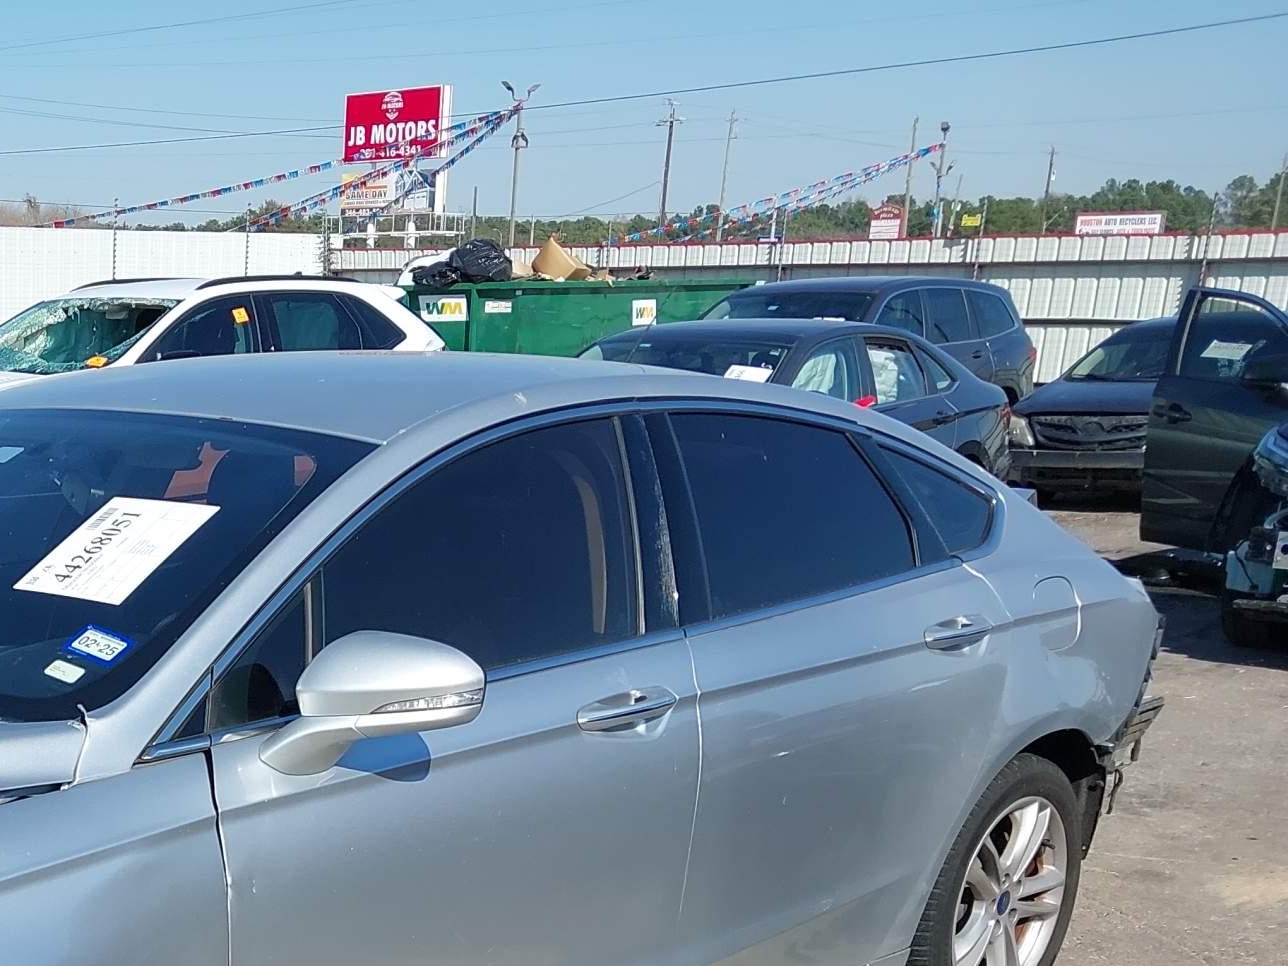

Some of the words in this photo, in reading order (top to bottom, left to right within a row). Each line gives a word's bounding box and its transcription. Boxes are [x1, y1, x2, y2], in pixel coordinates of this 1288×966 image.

[348, 125, 366, 147] JB
[370, 119, 436, 145] MOTORS
[345, 190, 369, 200] SAME
[372, 189, 388, 199] DAY
[425, 302, 464, 315] WM
[635, 306, 654, 319] WM
[54, 511, 142, 584] 44268051
